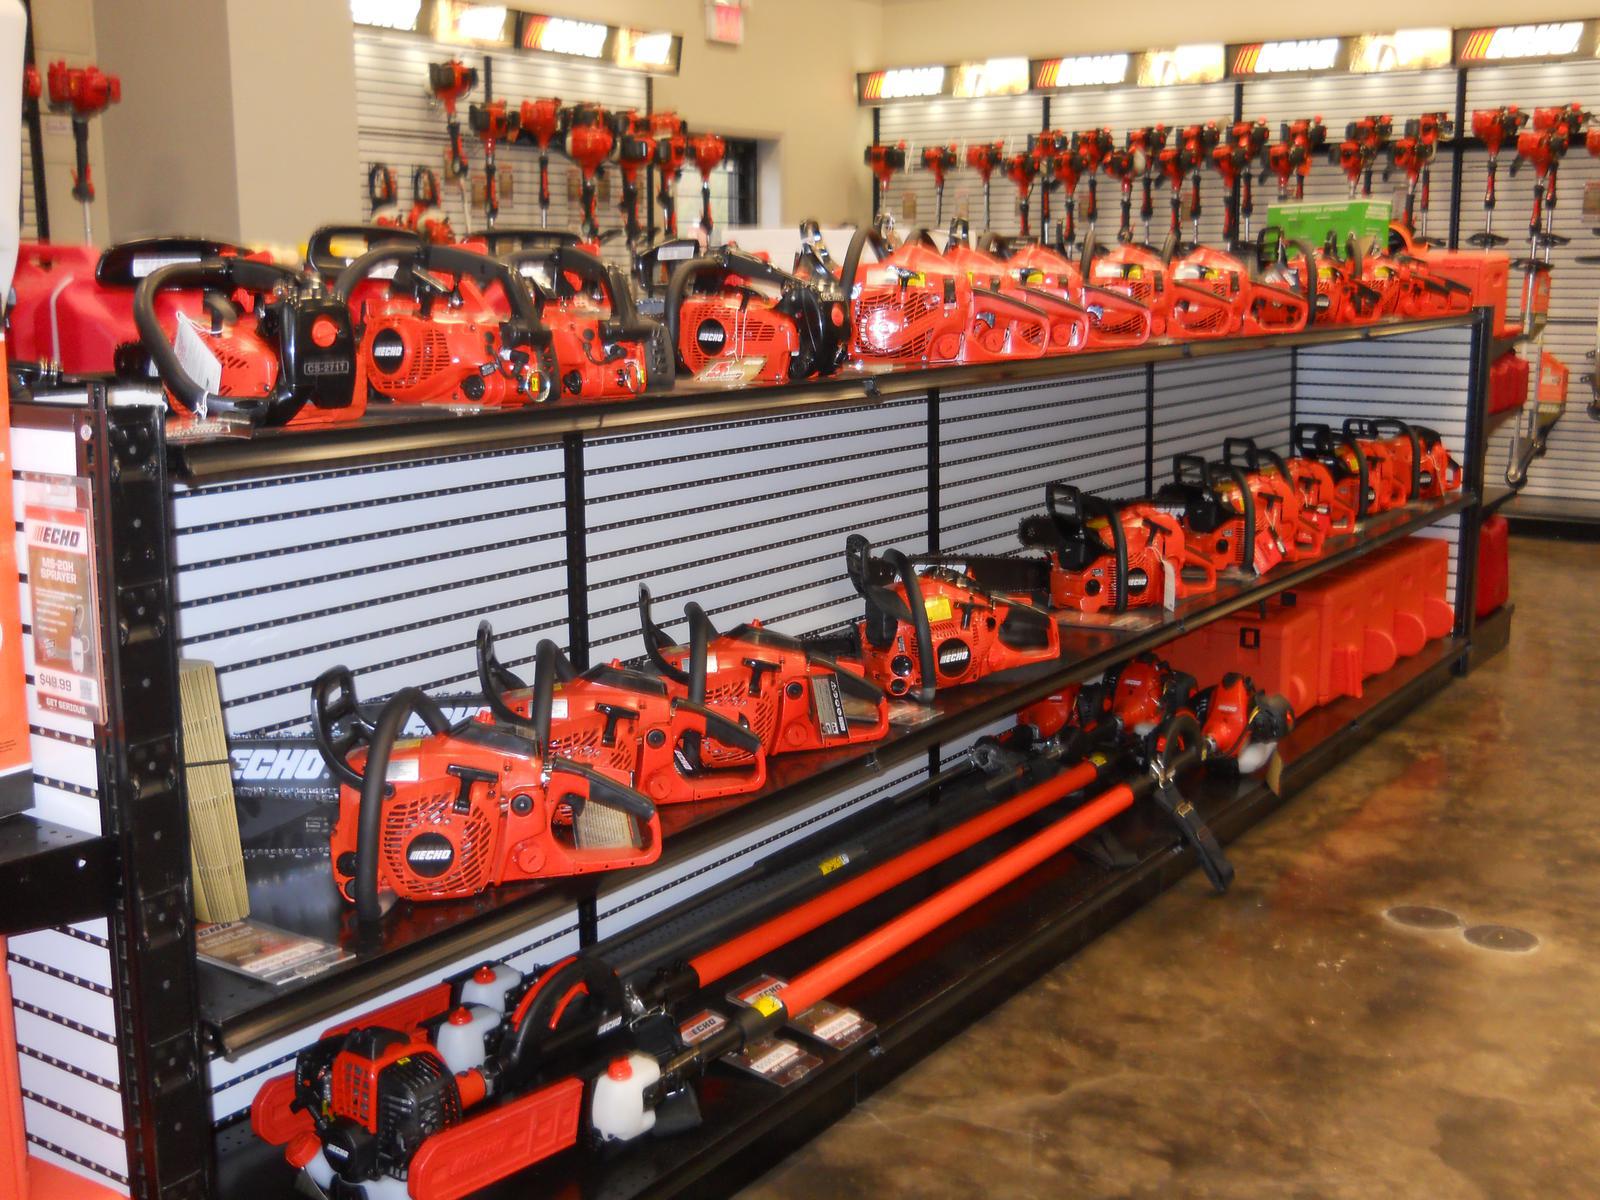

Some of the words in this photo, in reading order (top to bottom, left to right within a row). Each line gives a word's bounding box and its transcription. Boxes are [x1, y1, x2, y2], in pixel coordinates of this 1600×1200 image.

[703, 333, 724, 342] ECHO
[380, 346, 403, 357] ECHO
[42, 527, 80, 547] ECHO
[40, 568, 77, 585] SPRAYER
[944, 651, 969, 664] ECHO
[231, 749, 326, 780] ECHO
[416, 849, 452, 860] ECHO
[690, 1018, 716, 1035] ECHO
